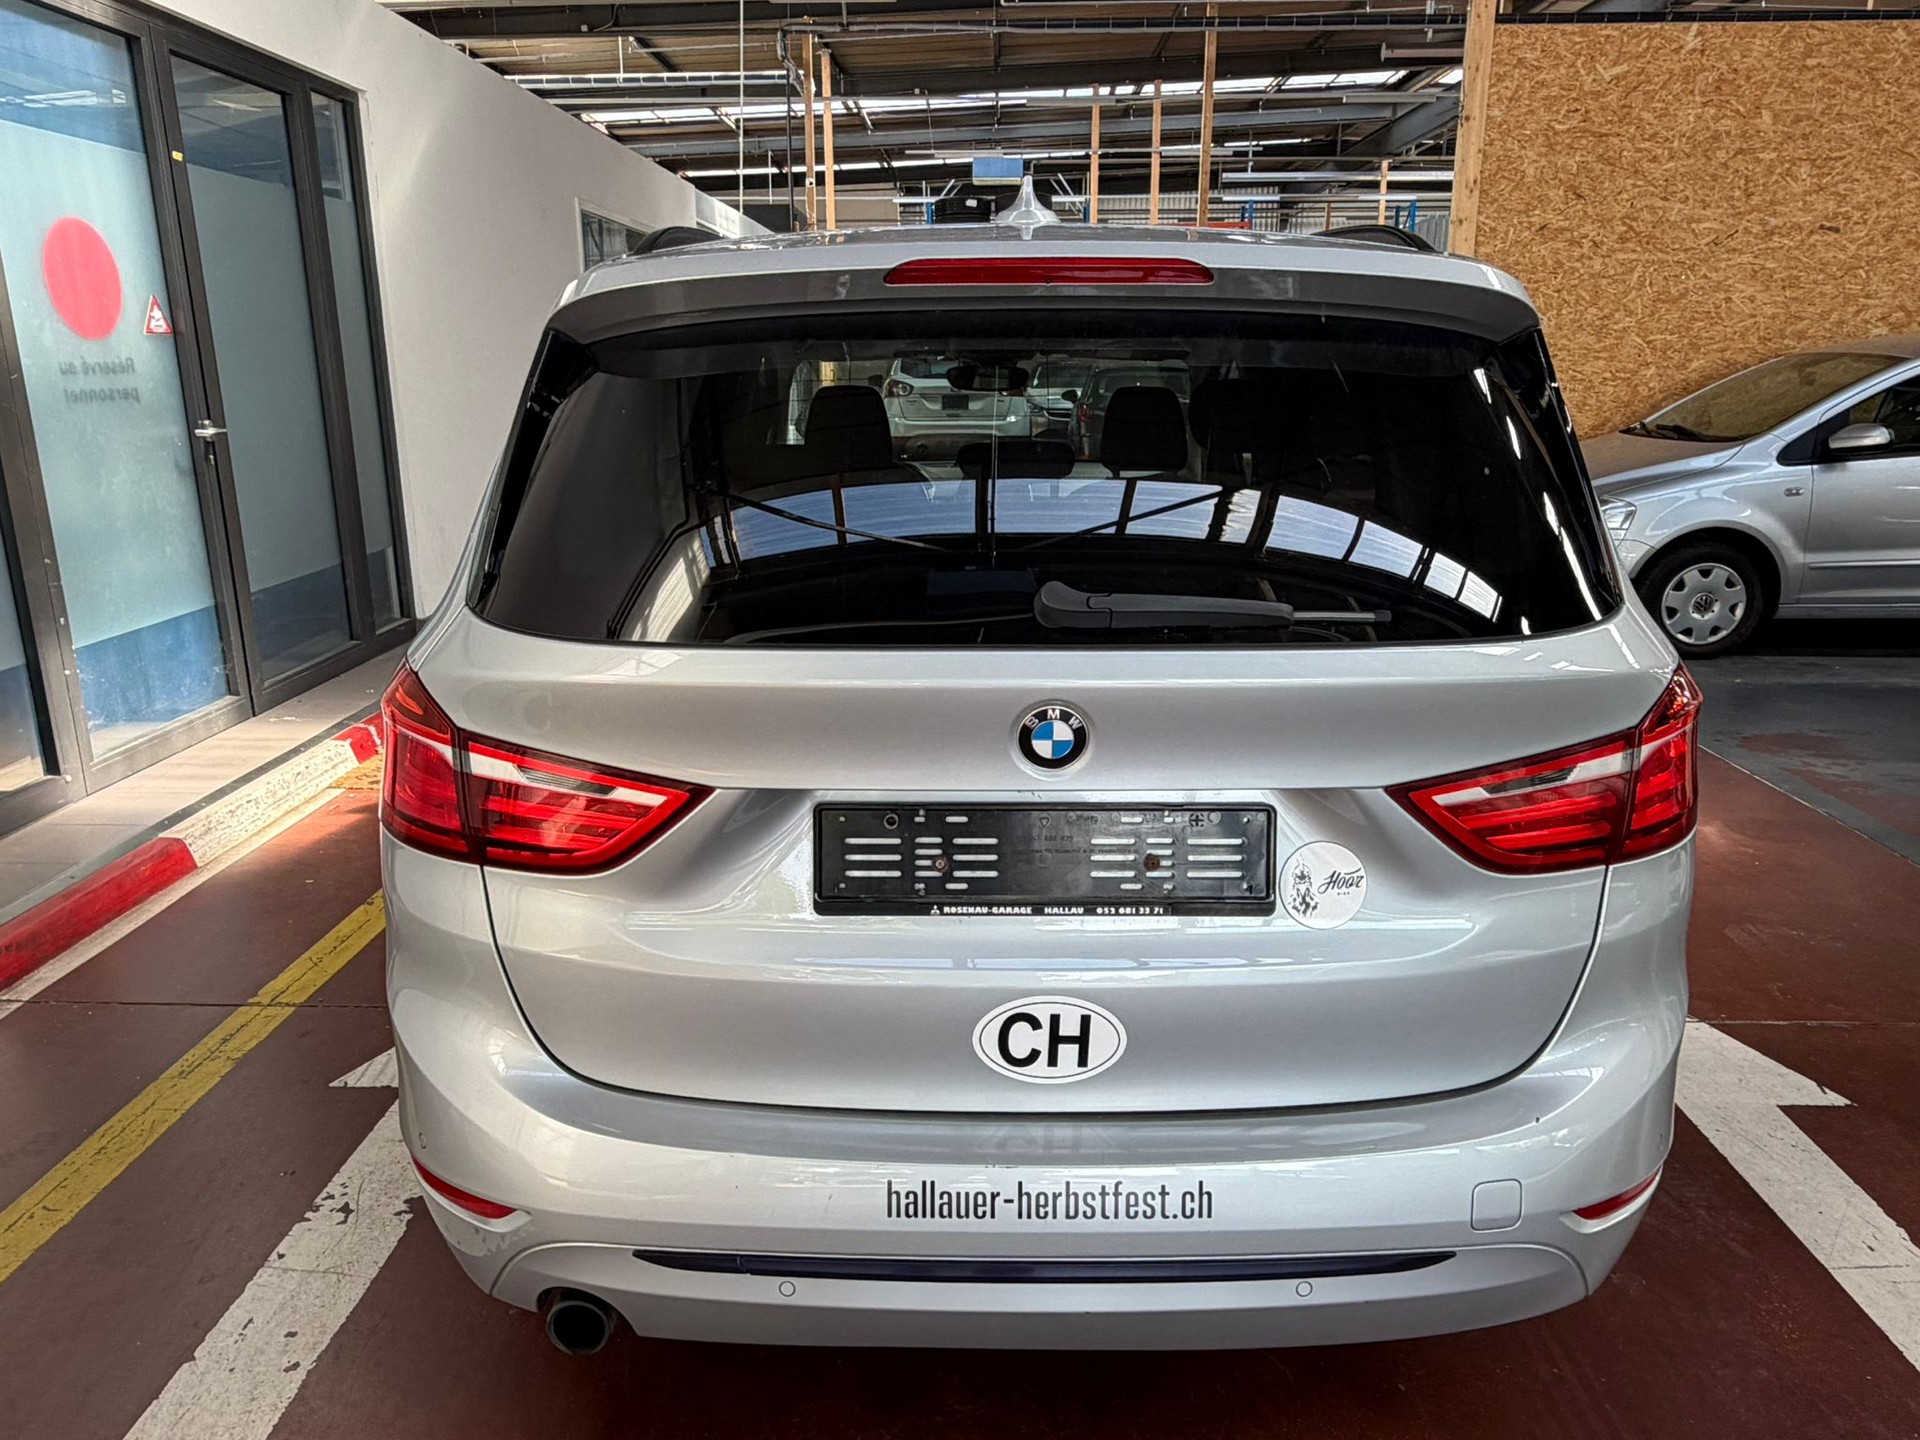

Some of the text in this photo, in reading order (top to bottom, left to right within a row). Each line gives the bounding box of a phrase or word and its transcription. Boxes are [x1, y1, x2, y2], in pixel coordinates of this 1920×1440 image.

[1025, 708, 1083, 730] BMW
[943, 906, 1033, 915] ROSENAU-GARAGE
[1096, 906, 1116, 915] 052
[1138, 906, 1151, 915] 33
[1153, 906, 1164, 915] 71
[997, 1012, 1092, 1068] CH
[886, 1179, 1214, 1220] hallauer-herbstfest.ch
